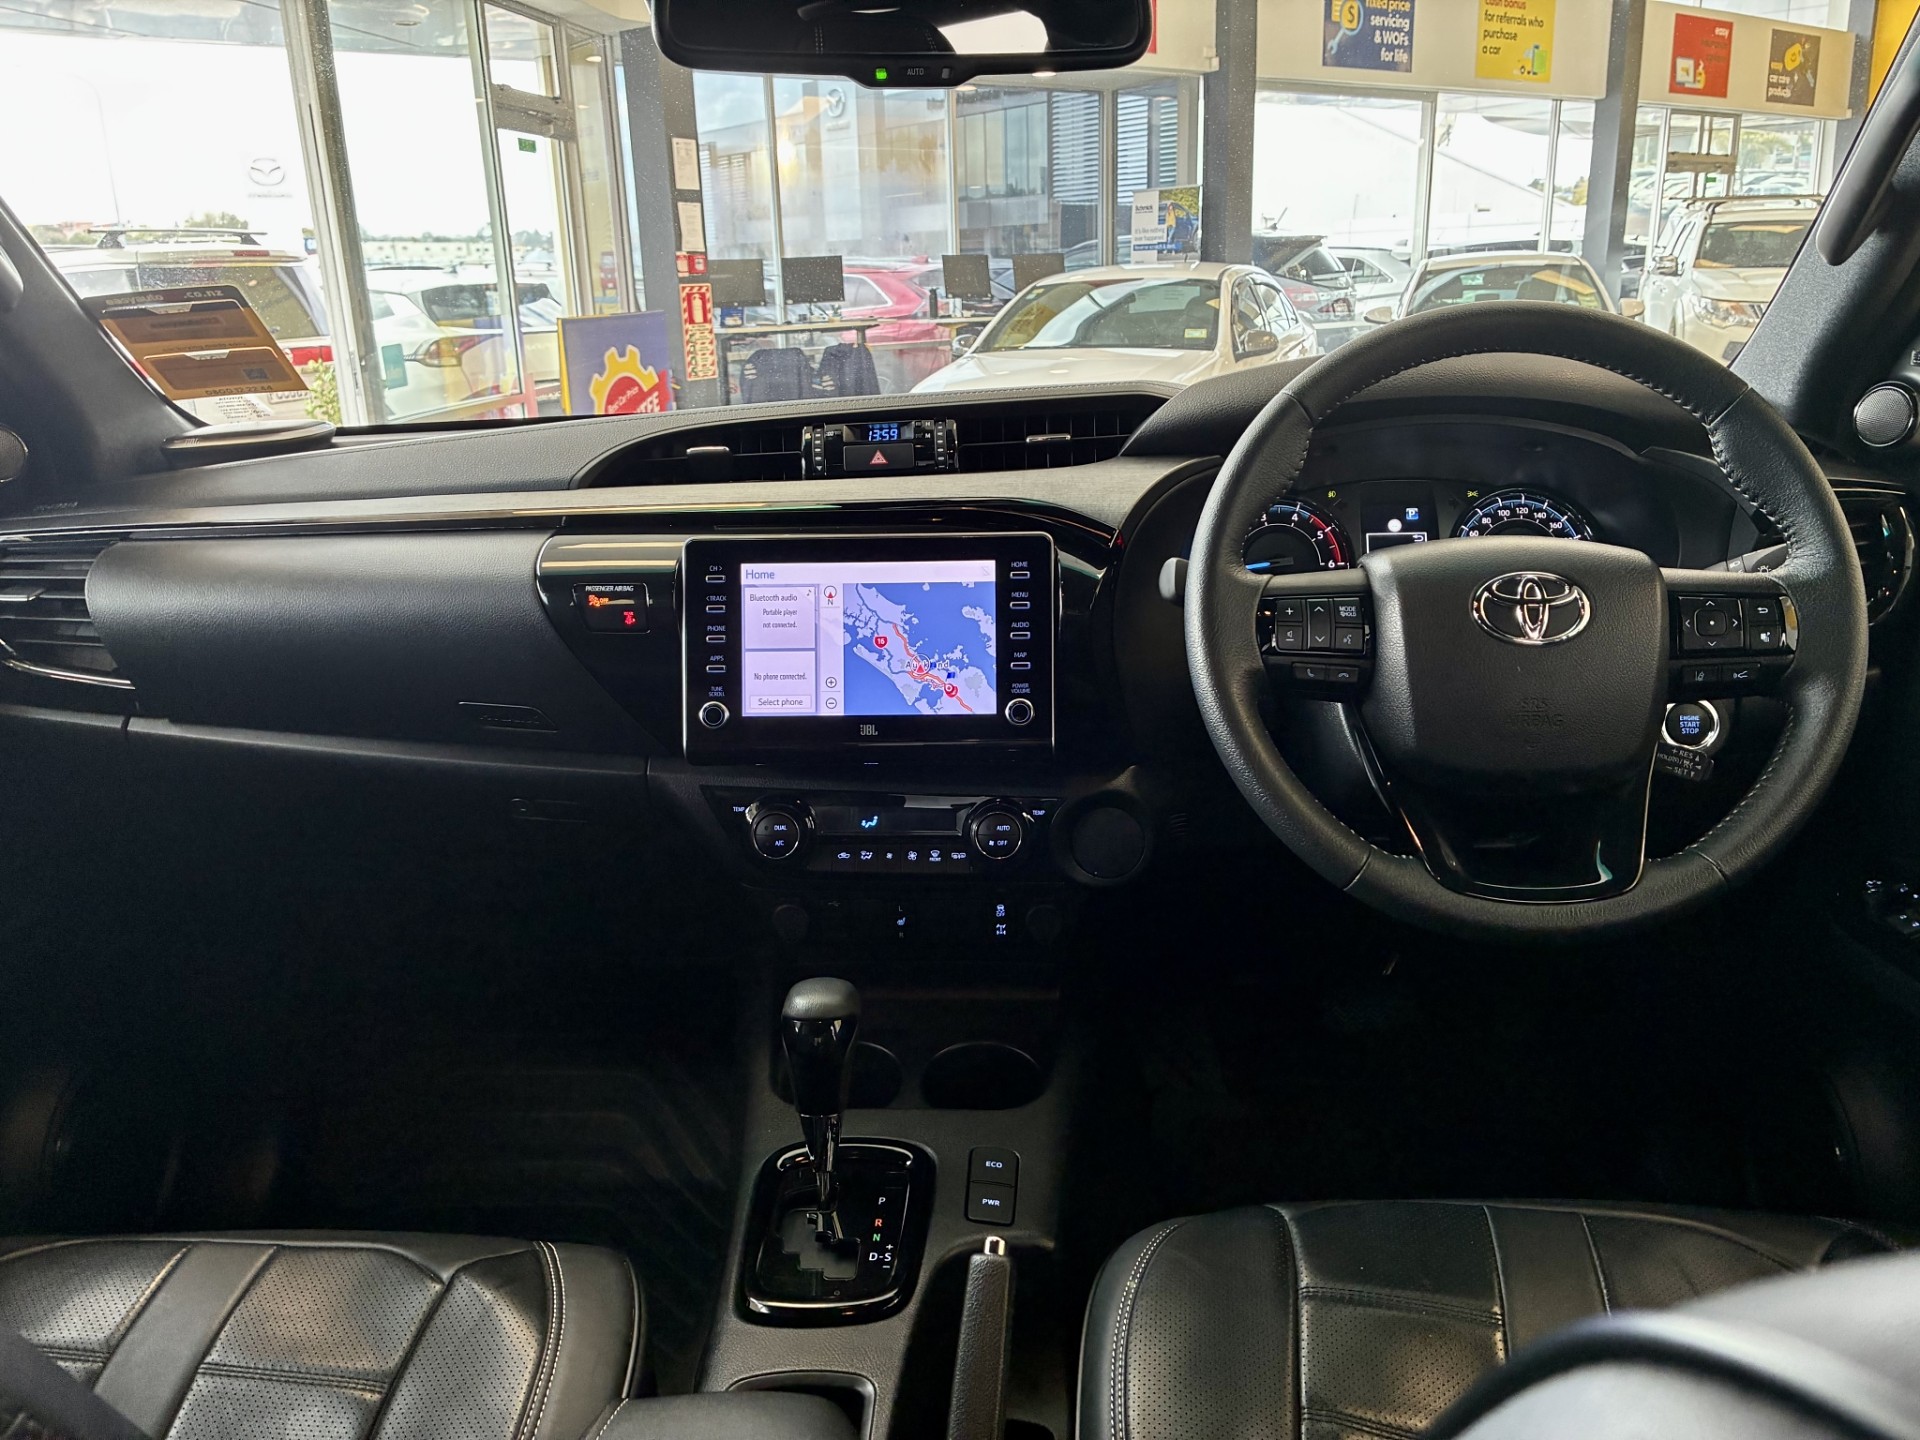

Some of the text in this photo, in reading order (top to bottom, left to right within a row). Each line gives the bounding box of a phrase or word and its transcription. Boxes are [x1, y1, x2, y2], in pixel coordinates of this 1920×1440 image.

[1370, 14, 1410, 32] servicing
[1484, 10, 1544, 28] for referrals who
[1374, 30, 1408, 46] & WOFs
[1484, 28, 1517, 41] purchase
[1381, 47, 1408, 63] for life
[1482, 46, 1502, 54] a car
[868, 428, 898, 442] 13:59
[745, 569, 775, 580] Home
[783, 609, 797, 617] player
[763, 673, 778, 681] phone
[758, 698, 803, 707] Select phone
[860, 724, 879, 736] JBL
[878, 1196, 886, 1205] P
[982, 1199, 1000, 1207] PWR
[875, 1218, 882, 1227] R
[872, 1233, 881, 1242] N
